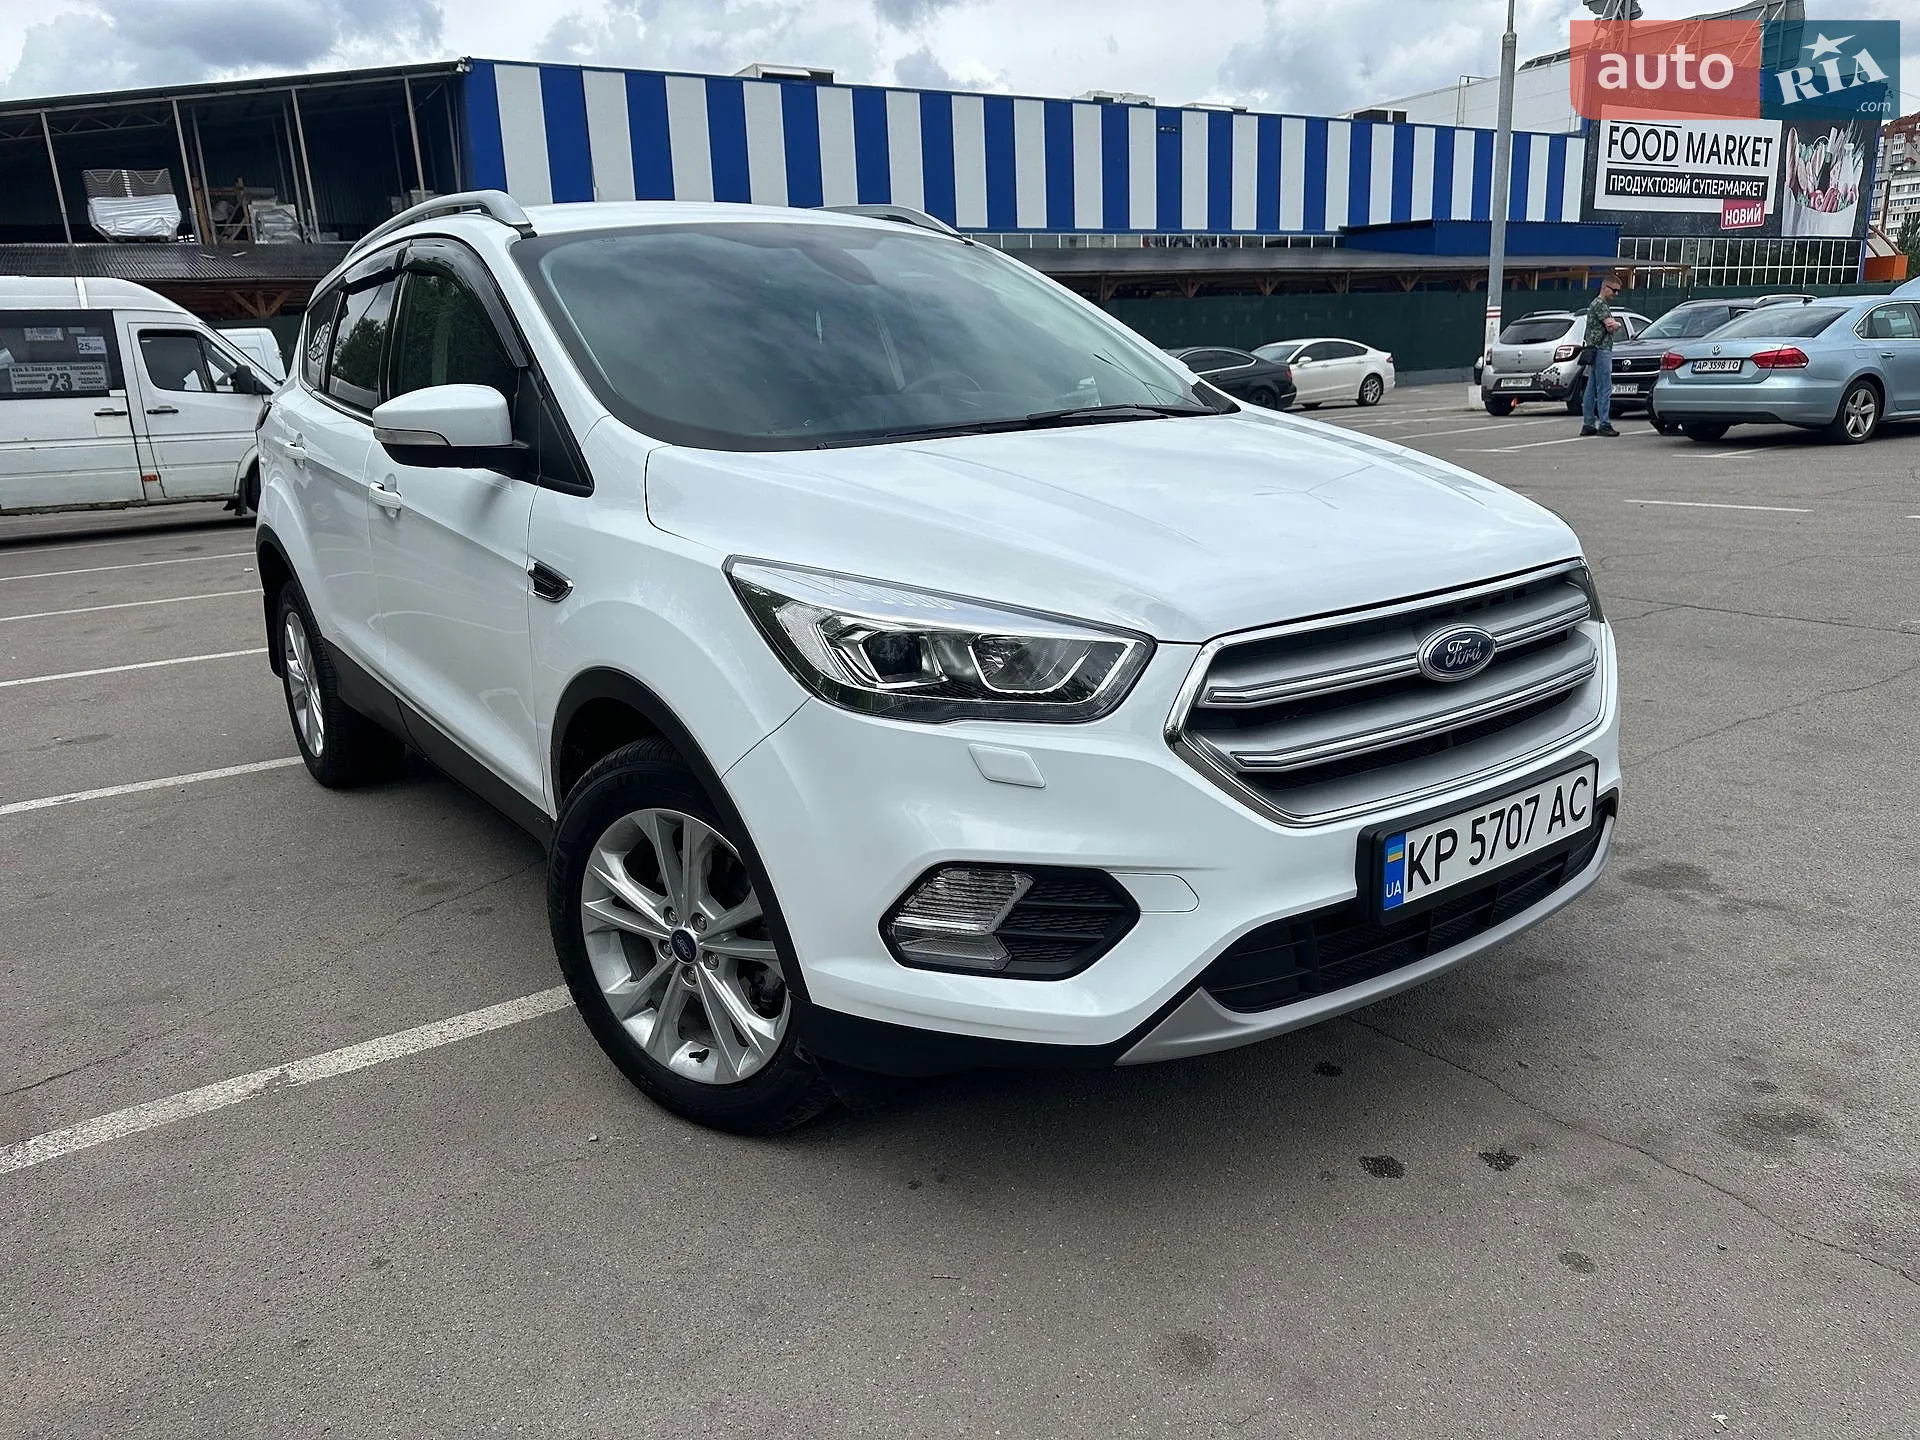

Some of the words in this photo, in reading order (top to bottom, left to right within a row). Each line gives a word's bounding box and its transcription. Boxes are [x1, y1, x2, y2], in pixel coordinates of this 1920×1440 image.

[1607, 125, 1679, 162] FOOD
[1685, 131, 1773, 168] MARKET
[1609, 174, 1690, 195] ПРОДУКТОВИЙ
[1692, 179, 1765, 197] СУПЕРМАРКЕТ
[1725, 203, 1762, 226] НОВИЙ
[1696, 360, 1708, 370] AP
[1708, 360, 1726, 370] 3598
[47, 373, 73, 391] 23
[1445, 637, 1482, 667] Ford
[1407, 827, 1458, 893] KP
[1468, 793, 1540, 866] 5707
[1547, 775, 1588, 835] AC
[1385, 879, 1402, 898] UA
